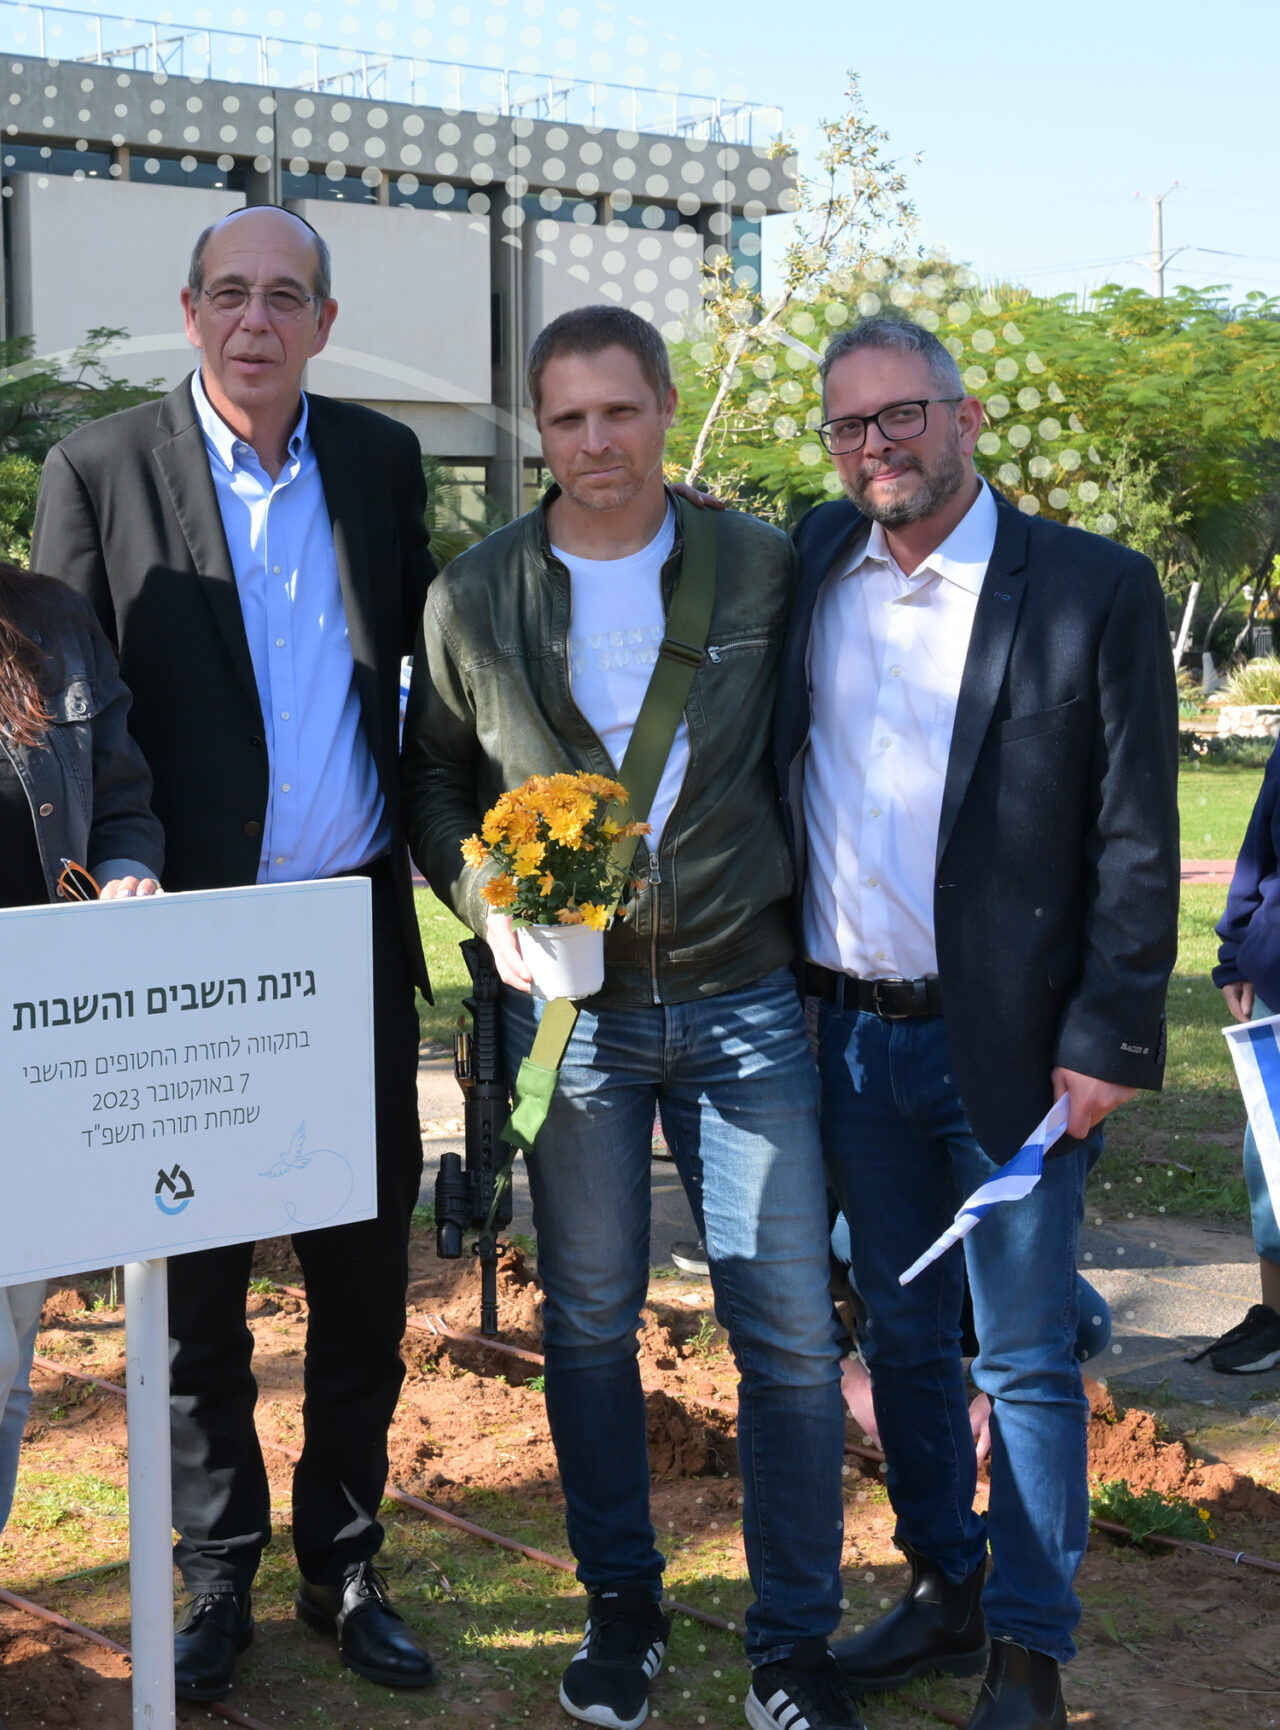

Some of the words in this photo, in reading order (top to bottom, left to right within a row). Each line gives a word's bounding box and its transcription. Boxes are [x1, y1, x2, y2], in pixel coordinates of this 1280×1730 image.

[146, 977, 247, 1016] השבים
[256, 970, 317, 1003] גינת
[12, 989, 135, 1032] והשבות
[183, 1035, 241, 1064] לחזרת
[247, 1030, 311, 1055] בתקווה
[22, 1059, 88, 1085] מהשבי
[95, 1047, 177, 1076] החטופים
[146, 1075, 235, 1103] באוקטובר
[239, 1072, 251, 1095] 7
[92, 1088, 140, 1112] 2023
[152, 1114, 198, 1138] תורה
[203, 1105, 261, 1130] שמחת
